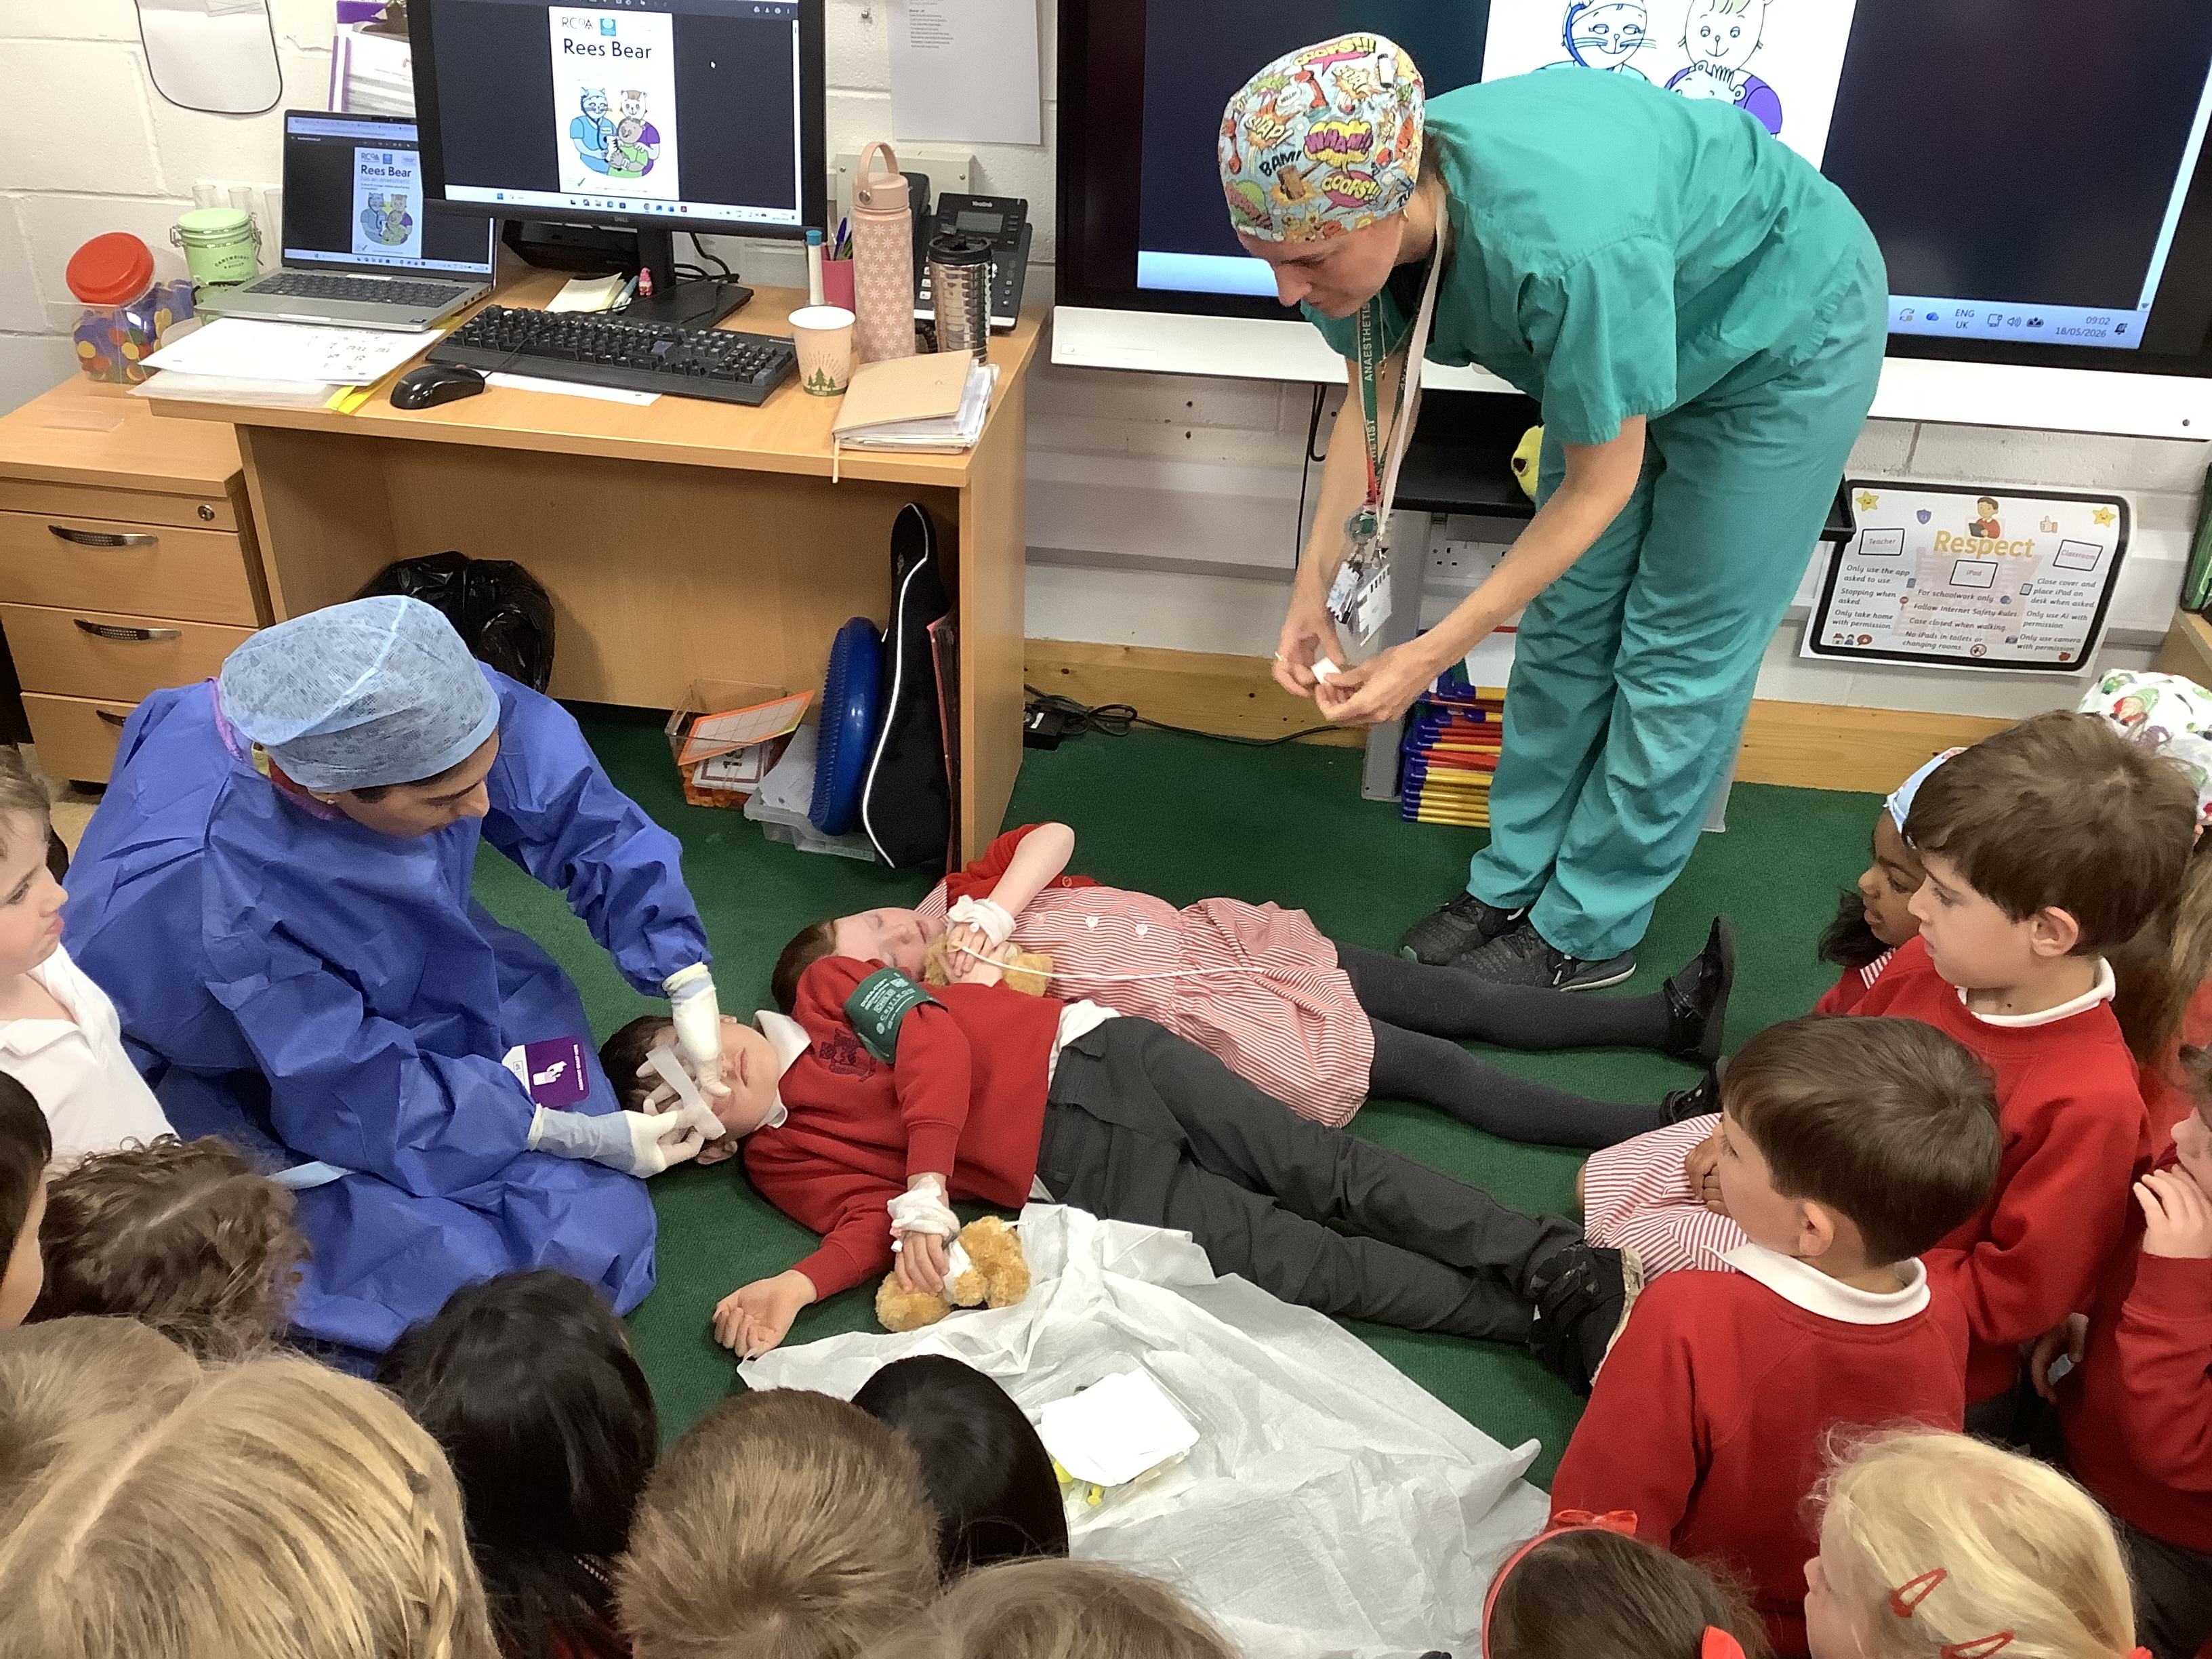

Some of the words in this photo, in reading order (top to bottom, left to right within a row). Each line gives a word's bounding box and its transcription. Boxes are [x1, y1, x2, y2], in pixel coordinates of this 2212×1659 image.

[564, 38, 606, 56] Rees
[611, 41, 652, 59] Bear
[1305, 128, 1374, 155] WHAM!!
[1259, 150, 1302, 177] BAM!
[361, 165, 385, 176] Rees
[388, 166, 411, 178] Bear
[1954, 308, 1975, 318] ENG
[1956, 321, 1969, 330] UK
[2085, 315, 2110, 326] 09:02
[2055, 326, 2107, 338] 18/05/2026
[1933, 530, 2035, 559] Respect
[2061, 549, 2096, 560] Classroom
[1846, 565, 1864, 573] Only
[1841, 588, 1874, 597] Stopping
[1932, 590, 1975, 600] schoolwork
[2033, 588, 2053, 596] place
[1835, 609, 1852, 618] Only
[1940, 606, 1971, 614] Internet
[1972, 608, 1996, 617] Safety
[2026, 610, 2044, 619] Only
[1929, 619, 1953, 627] closed
[1918, 632, 1938, 640] iPads
[1949, 634, 1972, 642] toilets
[2020, 634, 2037, 642] Only
[1902, 640, 1937, 649] changing
